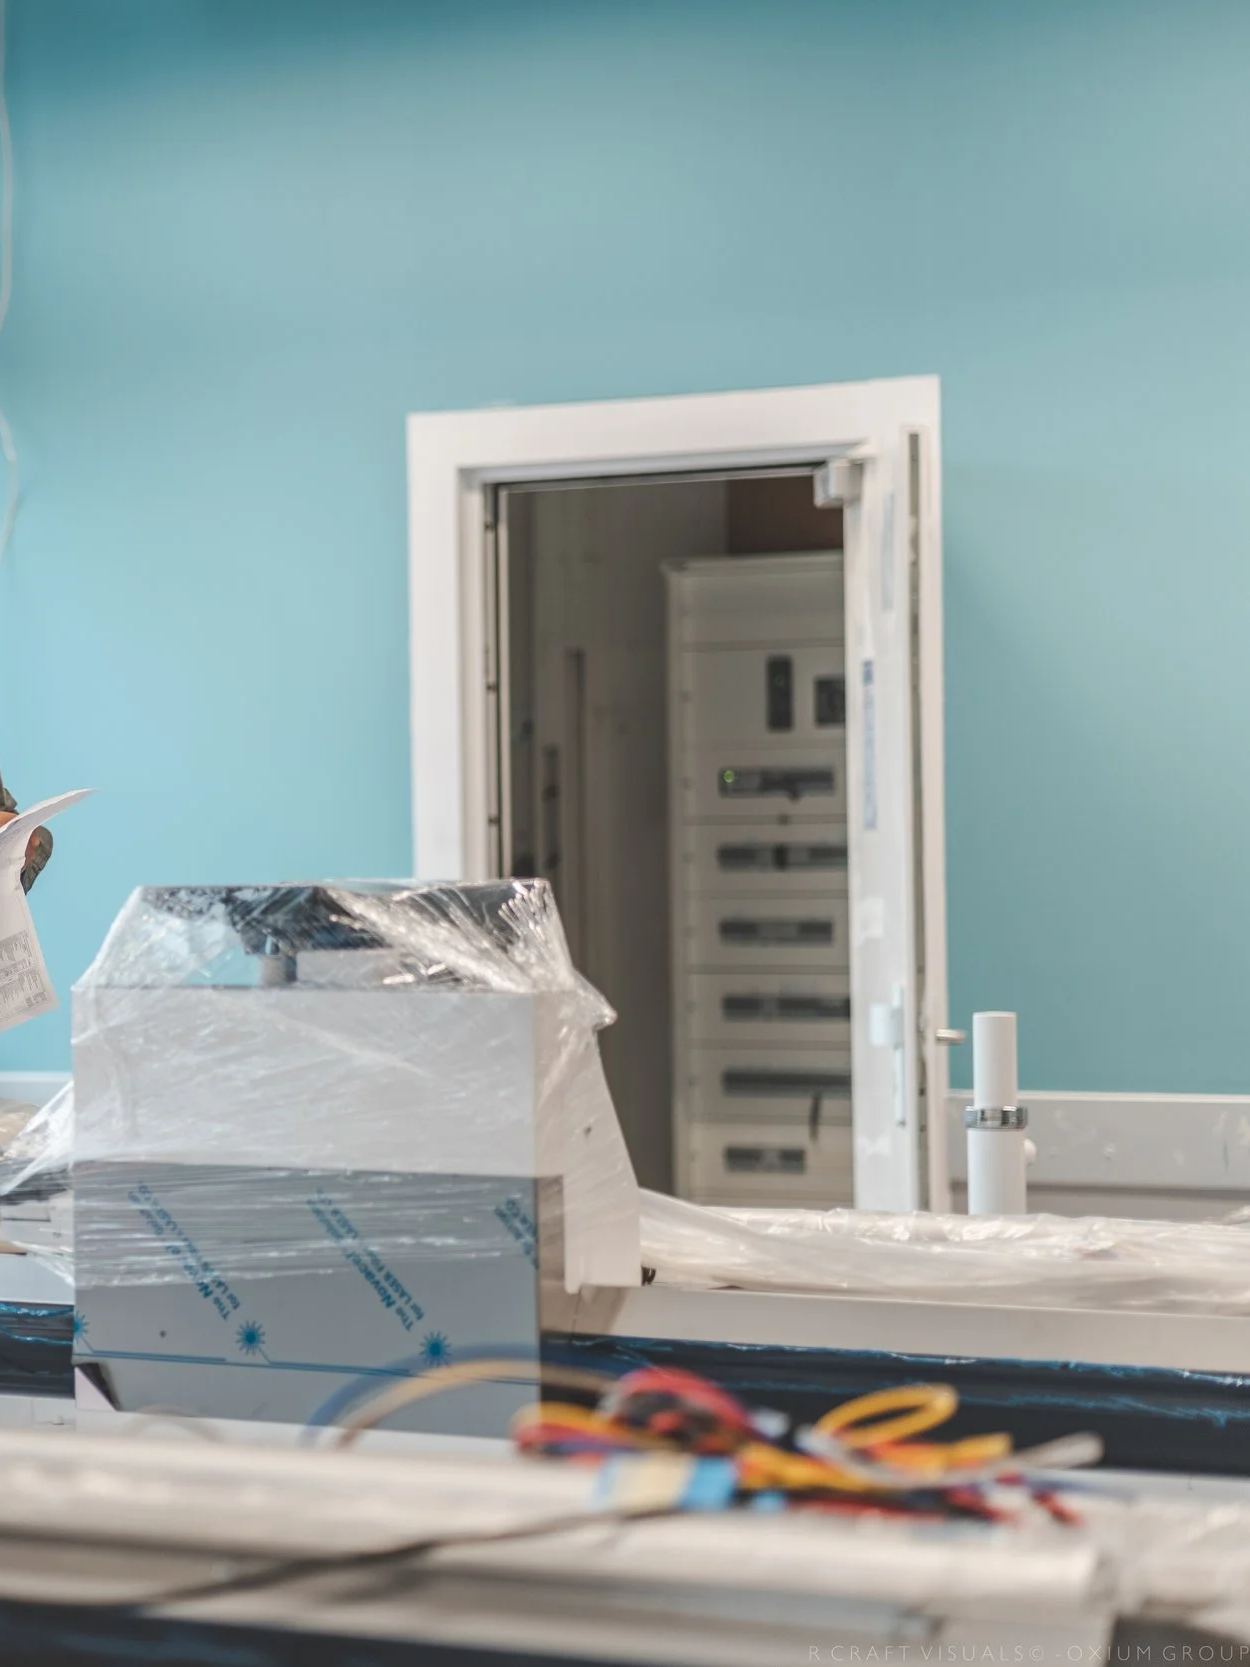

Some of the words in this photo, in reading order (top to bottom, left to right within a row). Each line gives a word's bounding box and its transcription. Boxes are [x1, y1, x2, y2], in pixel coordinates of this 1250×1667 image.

[345, 1251, 396, 1310] Novacel
[210, 1296, 231, 1321] The
[393, 1305, 414, 1332] The
